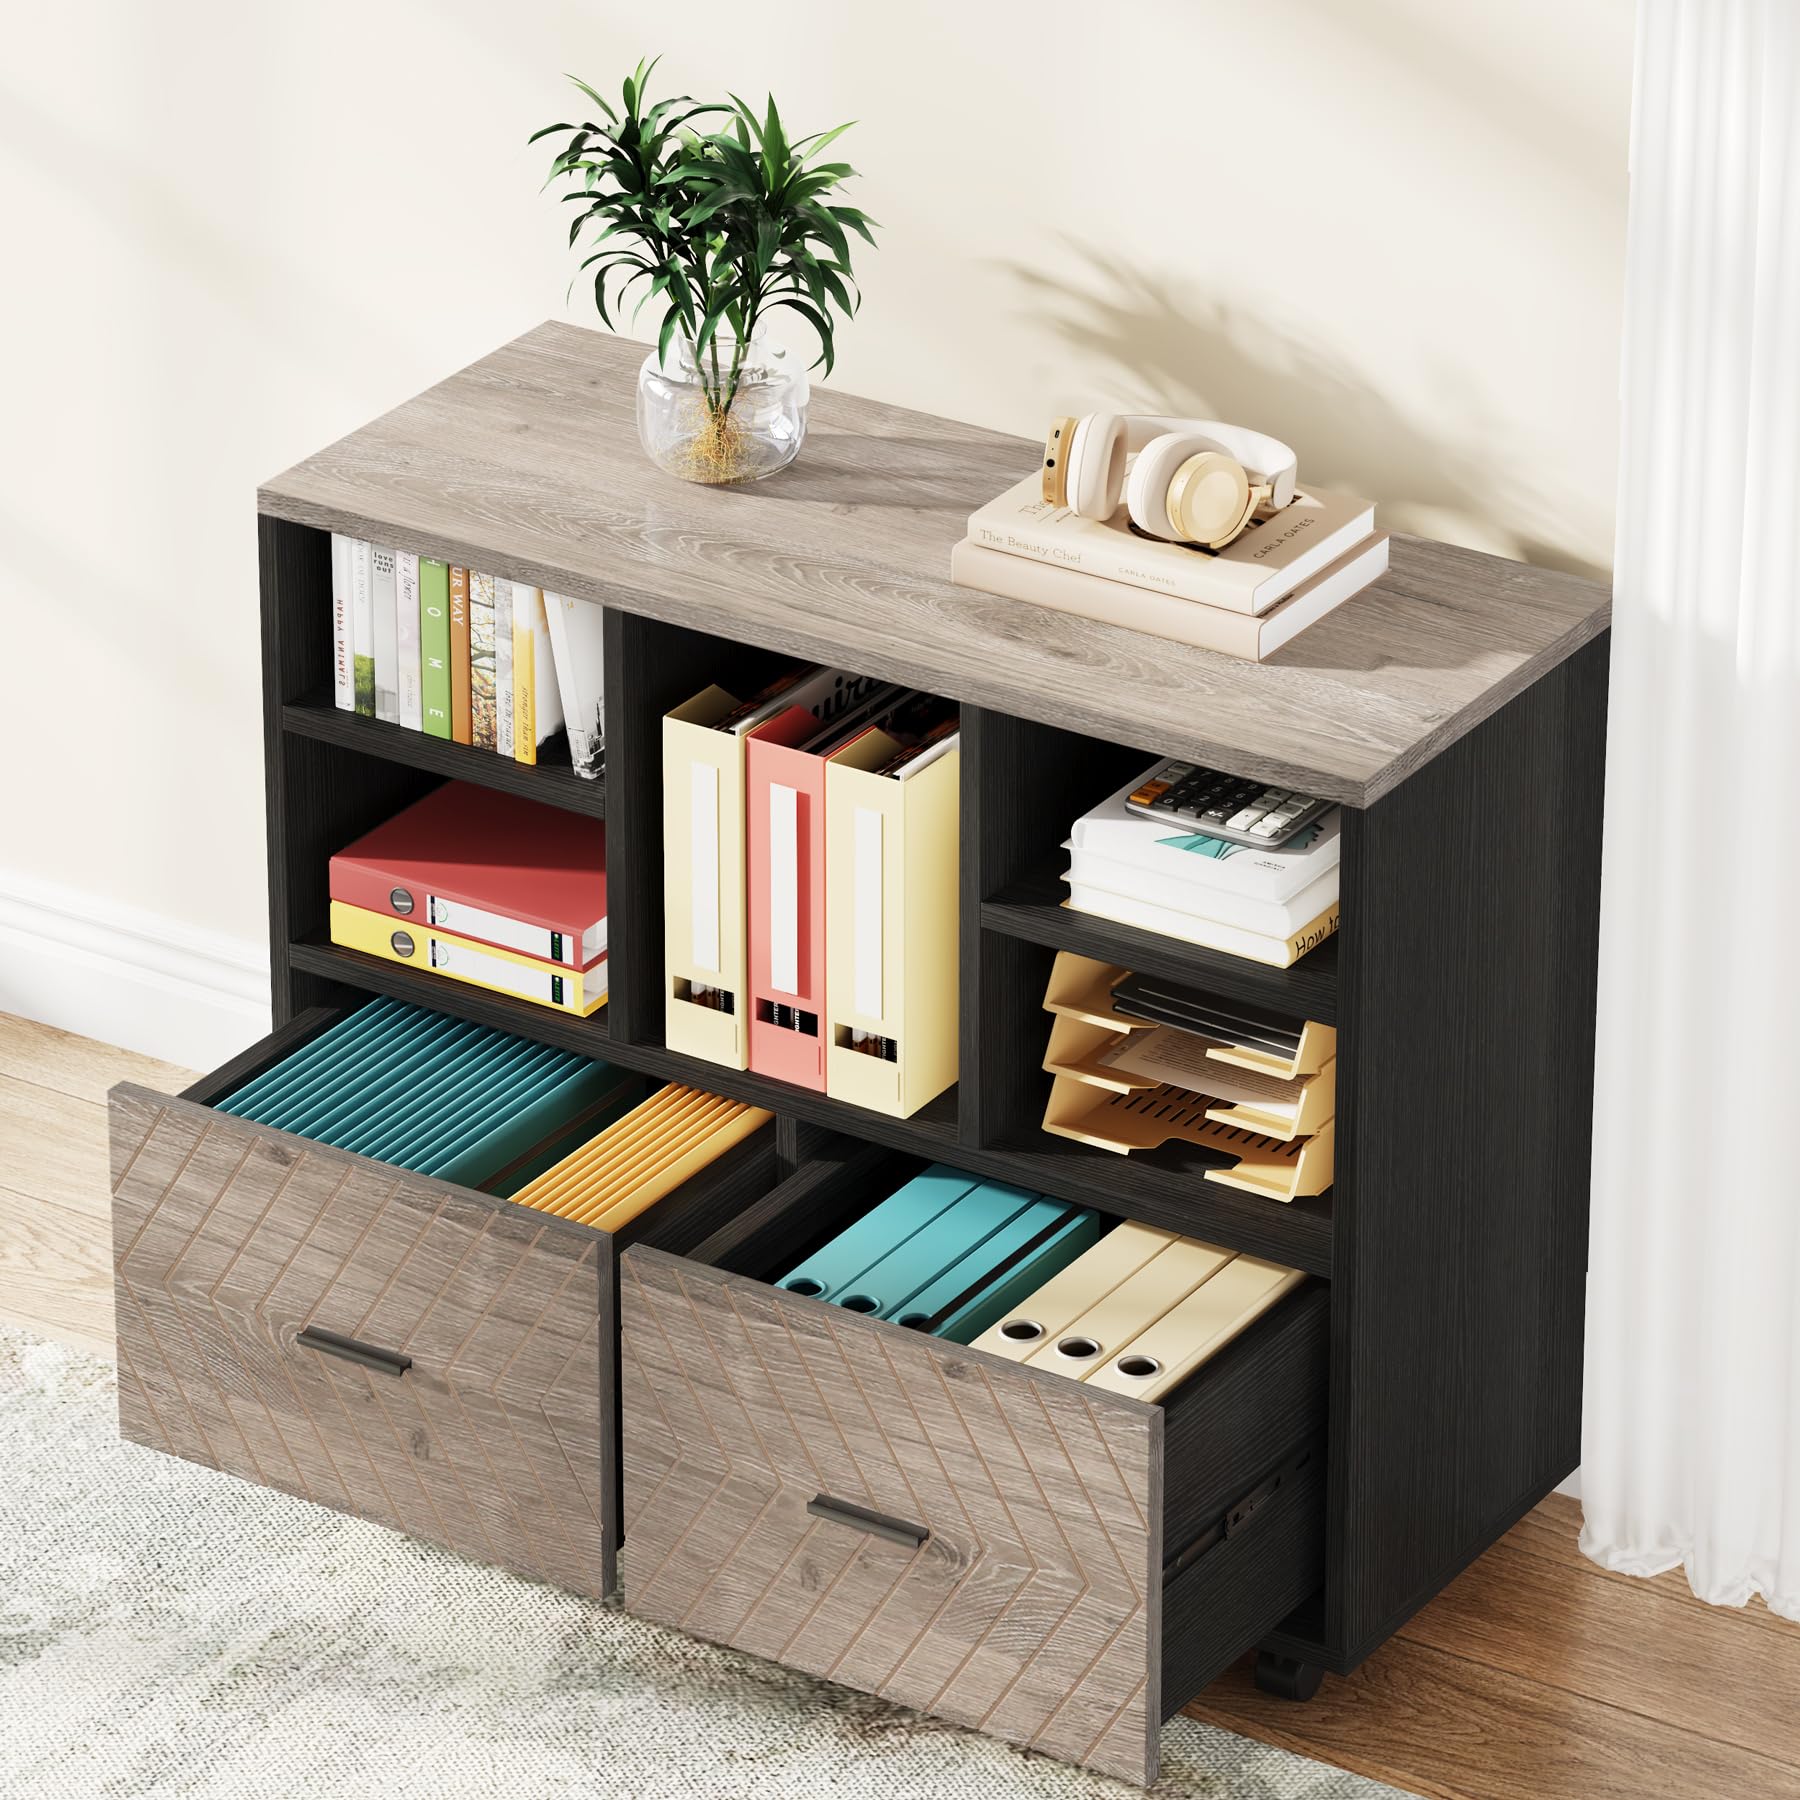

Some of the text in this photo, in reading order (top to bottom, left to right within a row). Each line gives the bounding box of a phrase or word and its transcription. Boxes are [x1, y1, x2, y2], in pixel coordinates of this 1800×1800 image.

[979, 528, 1004, 544] The
[1007, 536, 1049, 557] Beauty
[1253, 518, 1315, 559] CARLA OATES
[373, 551, 394, 562] love
[373, 559, 394, 569] runs
[376, 565, 392, 574] out
[1117, 567, 1177, 587] CARLA OATES
[453, 594, 464, 627] WAY
[1295, 926, 1326, 958] How
